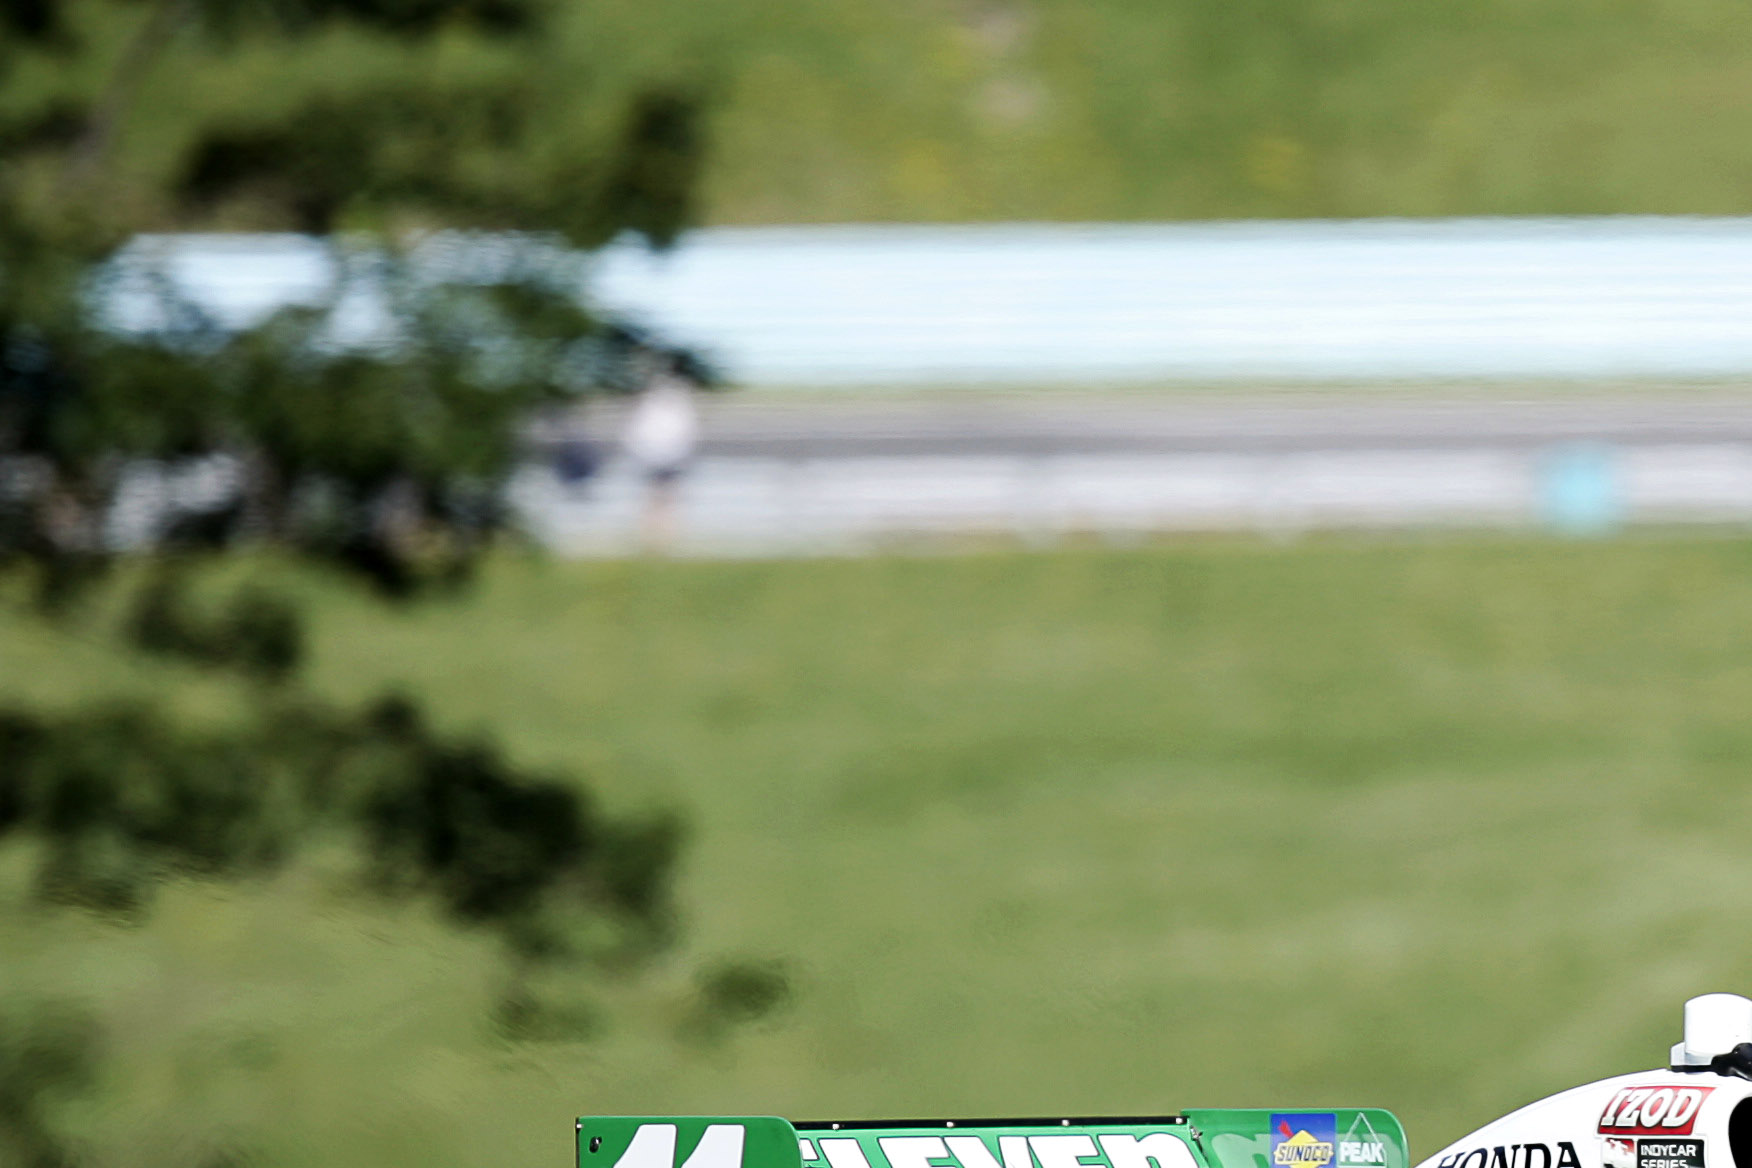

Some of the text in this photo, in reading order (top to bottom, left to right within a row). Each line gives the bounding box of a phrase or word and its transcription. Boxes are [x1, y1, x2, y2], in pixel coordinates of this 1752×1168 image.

[1600, 1087, 1705, 1128] IZOD
[1278, 1144, 1331, 1162] SUNOCO
[1339, 1141, 1384, 1163] PEAK
[1640, 1144, 1697, 1157] INDYCAR
